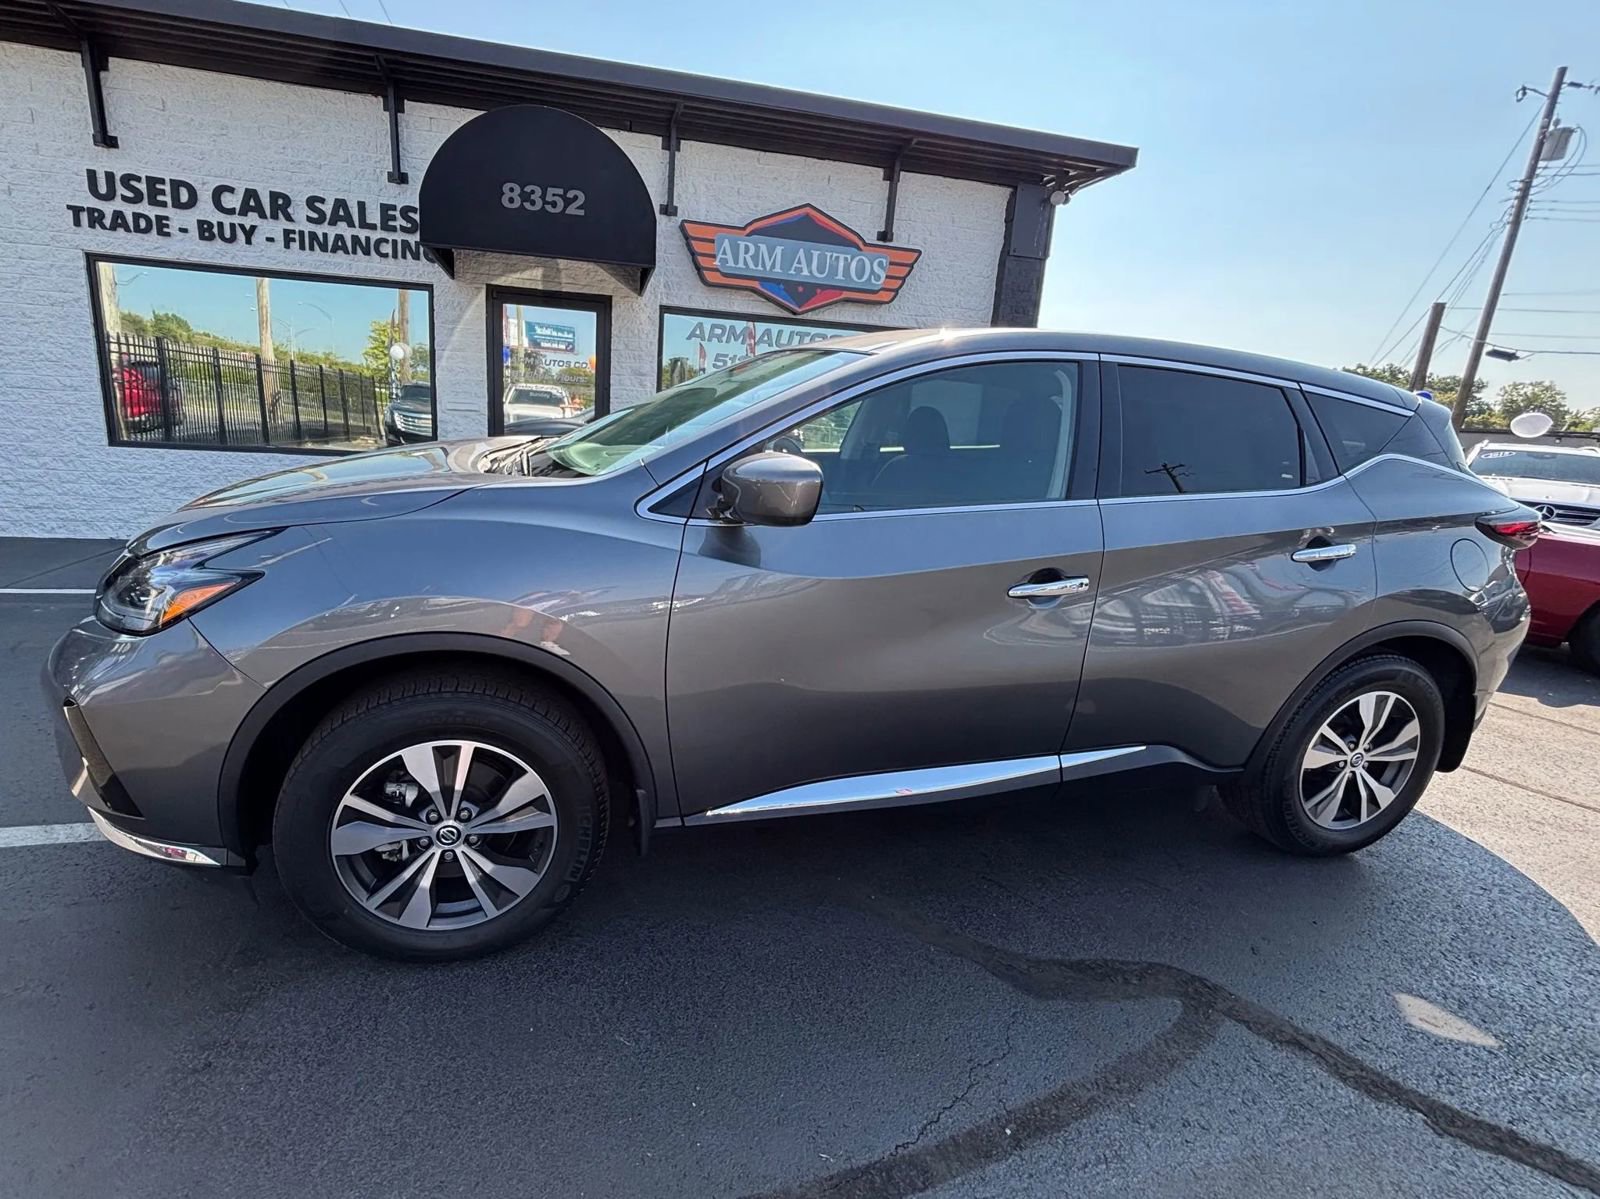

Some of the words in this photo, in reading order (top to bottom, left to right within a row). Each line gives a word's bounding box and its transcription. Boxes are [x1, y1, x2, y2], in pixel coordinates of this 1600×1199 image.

[85, 168, 199, 211] USED
[211, 184, 295, 223] CAR
[305, 195, 419, 235] SALES
[500, 181, 586, 216] 8352
[66, 204, 171, 238] TRADE
[197, 218, 258, 246] BUY
[713, 237, 784, 273] ARM
[788, 248, 888, 285] AUTOS
[686, 321, 748, 346] ARM
[755, 328, 845, 348] AUTO
[537, 358, 572, 369] AUTOS
